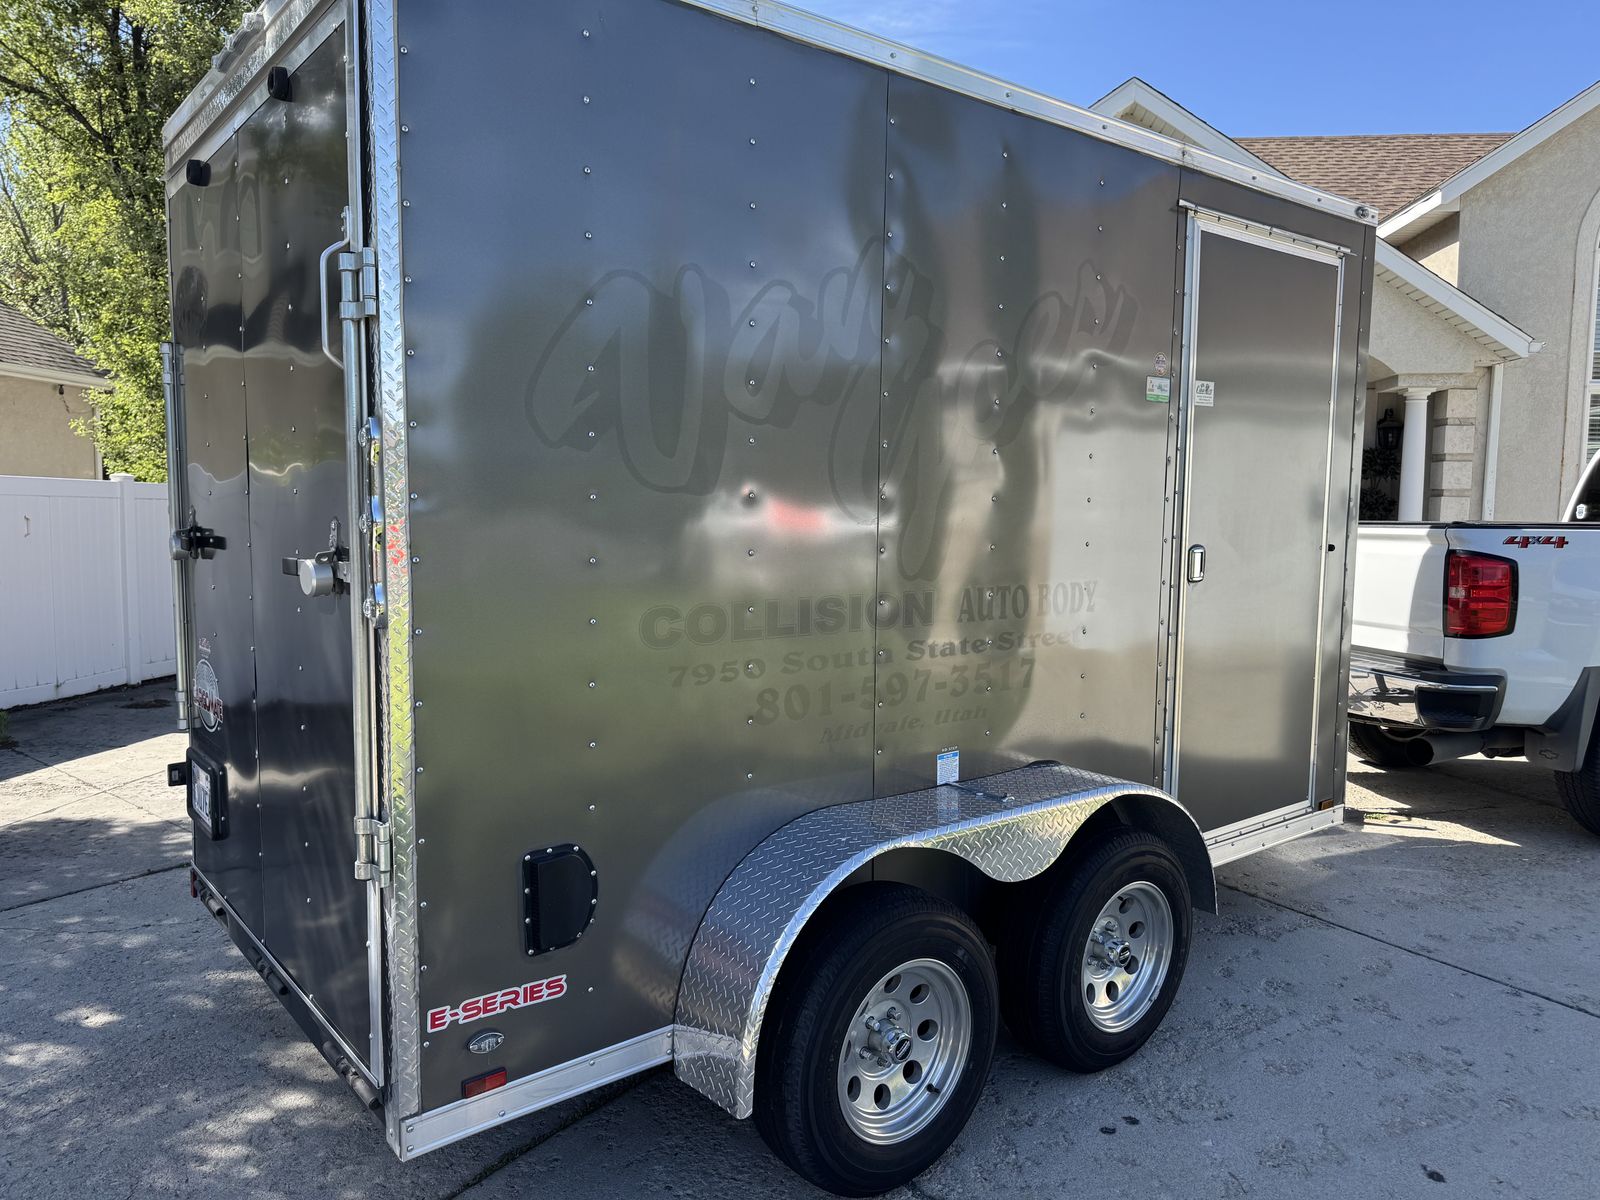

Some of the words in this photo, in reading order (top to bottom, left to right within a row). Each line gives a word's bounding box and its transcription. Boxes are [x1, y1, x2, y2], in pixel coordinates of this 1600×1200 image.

[639, 590, 935, 649] COLLISION
[957, 584, 1030, 623] AUTO
[1037, 579, 1099, 618] BODY
[668, 657, 766, 688] 7950
[781, 645, 893, 676] South
[906, 635, 989, 661] State
[997, 628, 1079, 651] Street
[753, 658, 1036, 726] 801-597-3517
[428, 973, 568, 1033] E-SERIES
